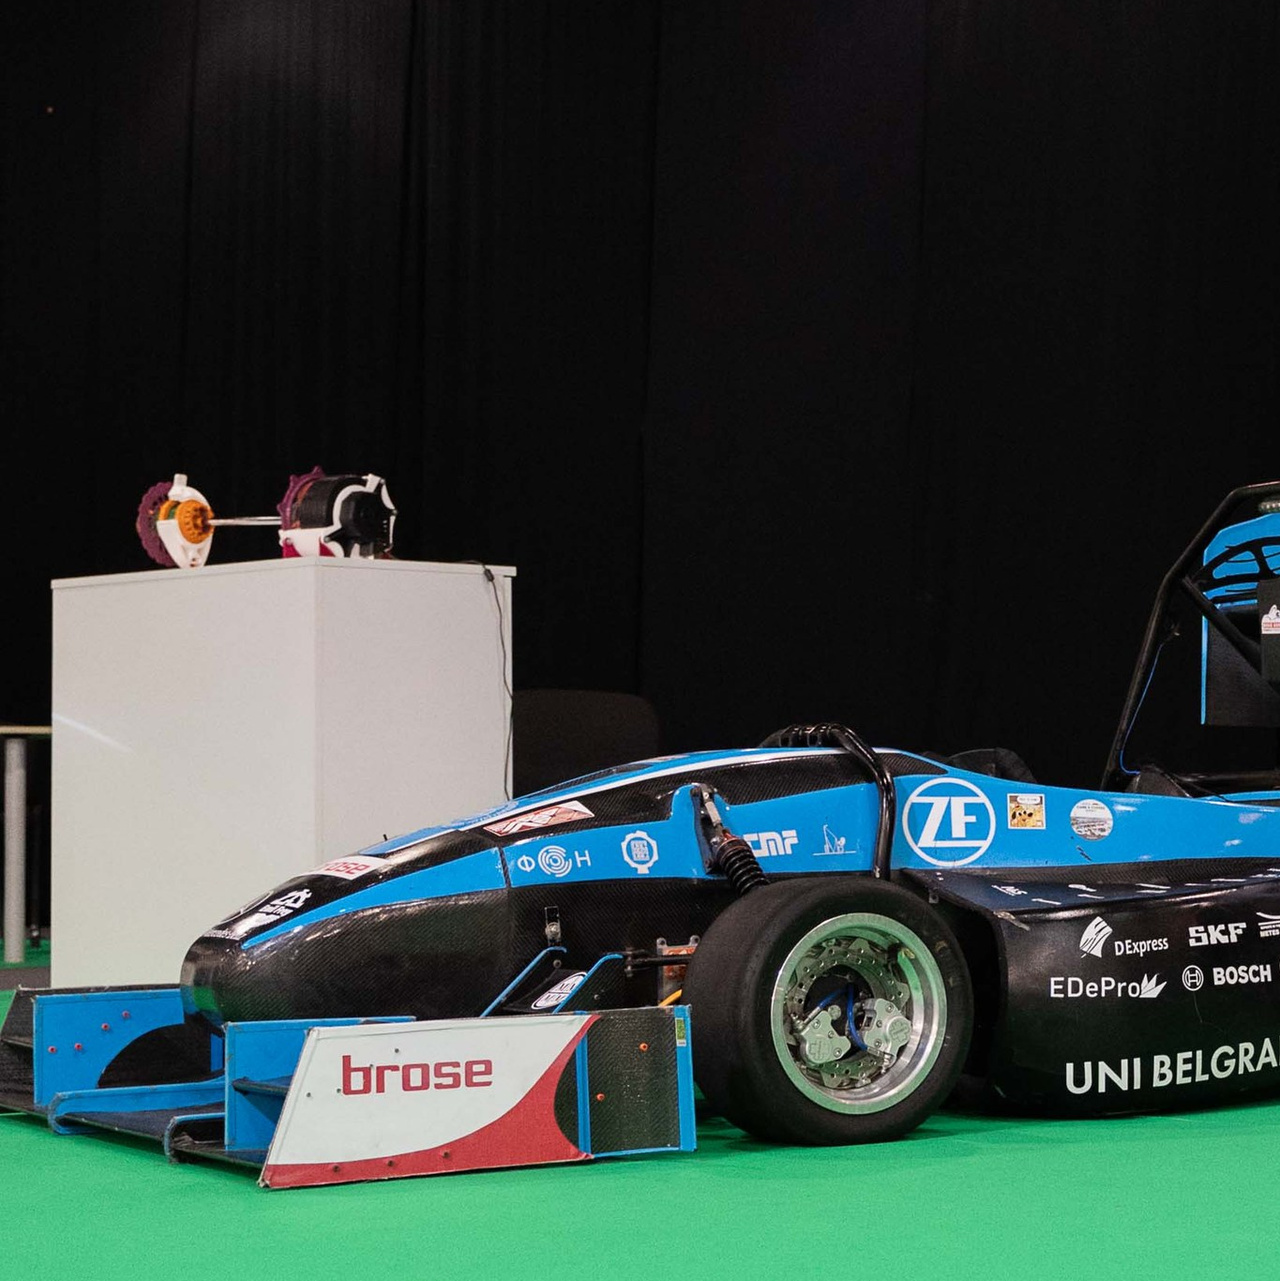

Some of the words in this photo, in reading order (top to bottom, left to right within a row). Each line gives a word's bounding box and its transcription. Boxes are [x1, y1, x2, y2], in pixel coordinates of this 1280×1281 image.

[905, 794, 990, 849] ZF
[1188, 922, 1247, 947] SKF
[1050, 977, 1142, 998] EDePro
[1212, 964, 1272, 986] BOSCH
[342, 1055, 493, 1096] brose
[1066, 1057, 1142, 1095] UNI
